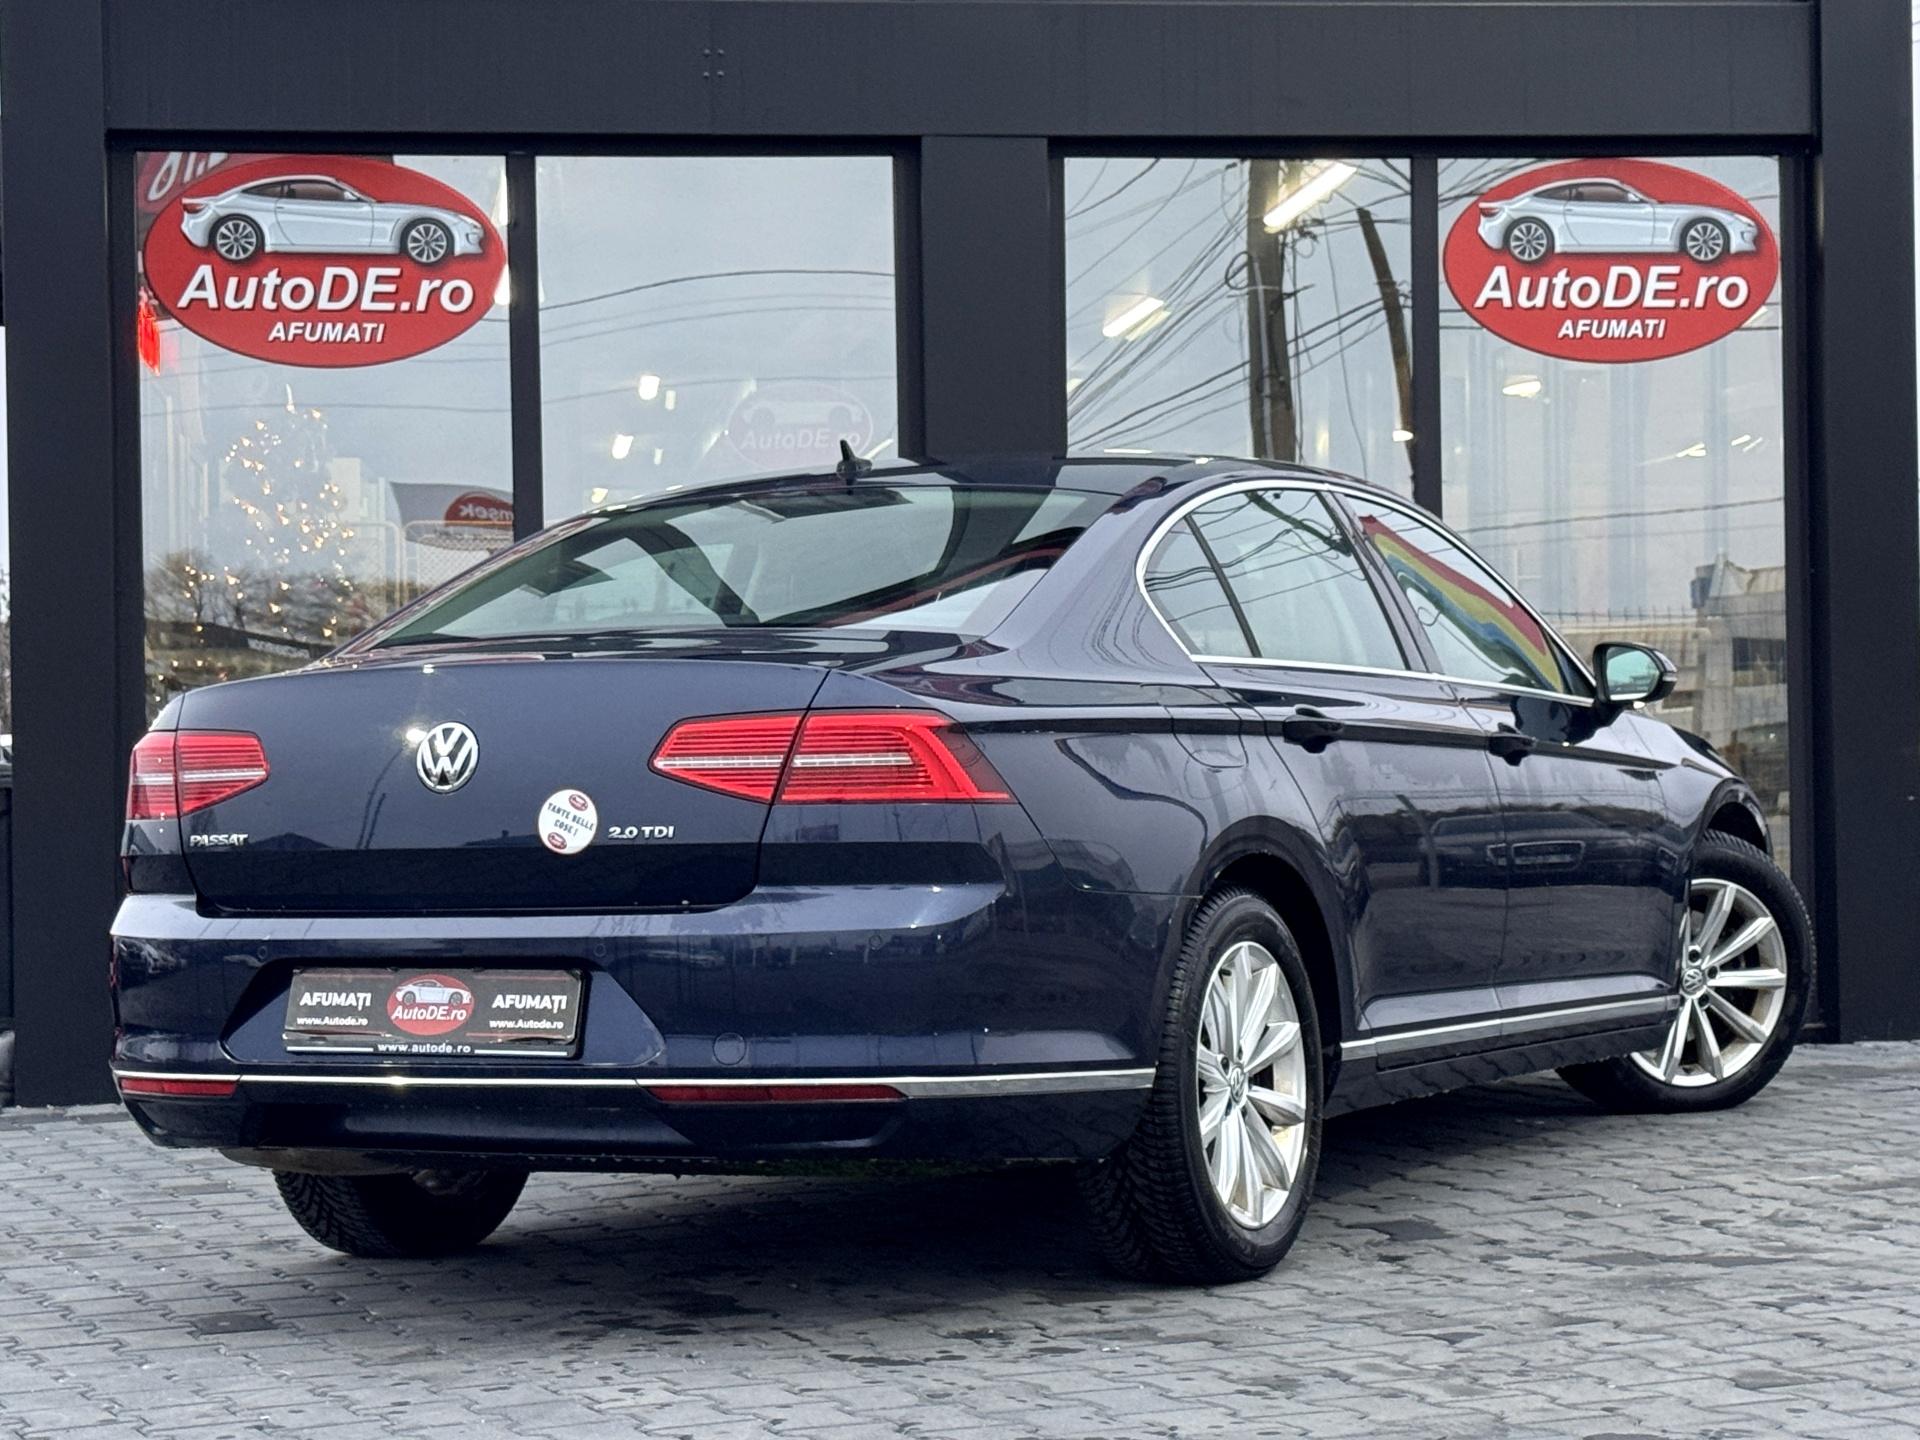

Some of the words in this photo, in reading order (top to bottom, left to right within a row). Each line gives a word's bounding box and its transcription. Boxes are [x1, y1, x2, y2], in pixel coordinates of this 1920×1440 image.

[178, 265, 474, 312] AutoDE.ro
[1474, 265, 1749, 309] AutoDE.ro
[269, 321, 386, 344] AFUMATI
[1558, 318, 1667, 339] AFUMATI
[547, 803, 572, 820] TANTE
[572, 814, 594, 832] BELLE
[190, 833, 249, 847] PASSAT
[608, 826, 638, 839] 2.0
[641, 825, 675, 838] TDI
[391, 1005, 467, 1021] AutoDE.ro
[296, 1016, 369, 1027] www.Autode.ro
[489, 1019, 565, 1030] www.Autode.ro
[377, 1042, 472, 1054] www.autode.ro
